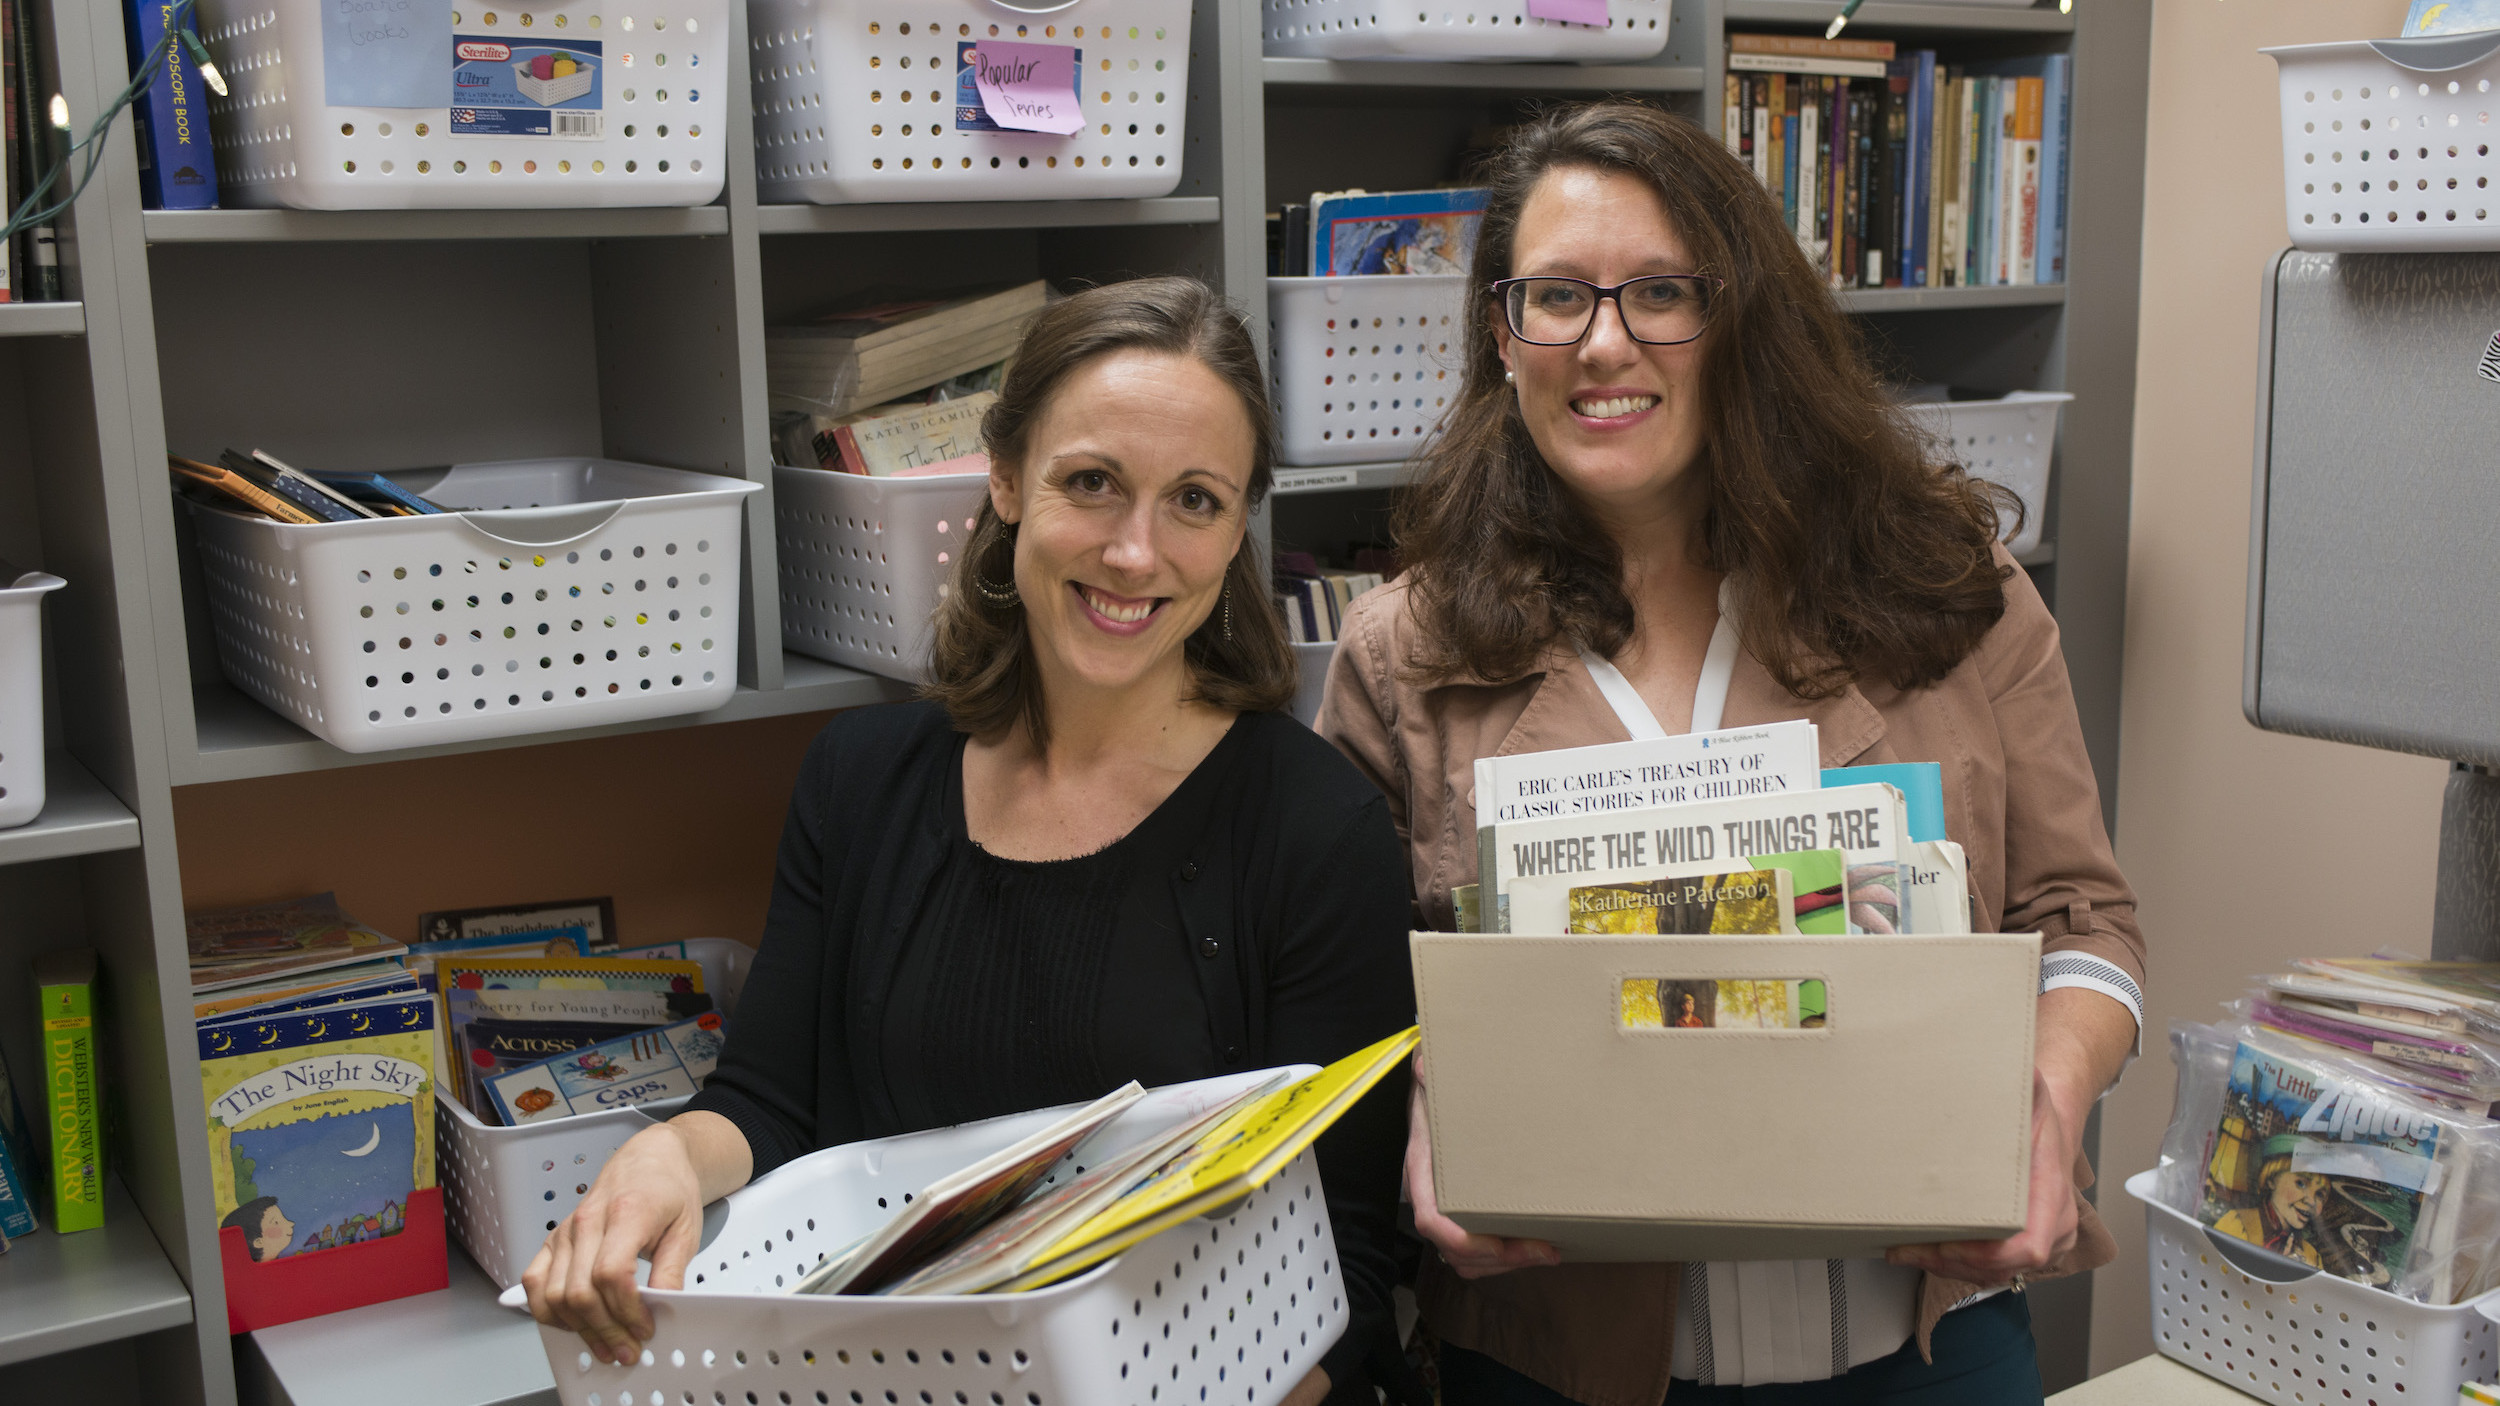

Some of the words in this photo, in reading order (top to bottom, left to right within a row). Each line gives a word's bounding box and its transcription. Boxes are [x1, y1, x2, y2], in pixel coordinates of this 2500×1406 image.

[462, 45, 504, 59] Sterilite
[161, 5, 187, 106] KAIDOSCOPE
[174, 108, 191, 145] BOOK
[456, 71, 491, 85] Ultra
[979, 53, 1041, 93] Popular
[864, 425, 904, 442] KATE
[911, 407, 986, 431] DiCAMILL
[900, 445, 933, 468] The
[276, 503, 305, 524] Farmer
[1518, 776, 1558, 797] ERIC
[1563, 768, 1633, 792] CARLE'S
[1638, 757, 1732, 784] TREASURY
[1740, 753, 1766, 772] OF
[1500, 799, 1567, 821] CLASSIC
[1572, 790, 1644, 813] STORIES
[1651, 784, 1687, 804] FOR
[1694, 774, 1788, 800] CHILDREN
[1513, 836, 1597, 877] WHERE
[1602, 831, 1647, 870] THE
[1656, 824, 1715, 864] WILD
[1723, 814, 1817, 858] THINGS
[1826, 807, 1881, 852] ARE
[1578, 888, 1678, 915] Katherine
[1684, 879, 1773, 906] Paterson
[469, 927, 495, 939] The
[468, 1000, 522, 1015] Poetry
[530, 1000, 555, 1012] for
[560, 1002, 608, 1018] Young
[613, 1001, 667, 1020] People
[490, 1034, 577, 1053] ACROSS
[73, 1037, 92, 1116] WEBSTER'S
[218, 1084, 276, 1116] The
[281, 1059, 364, 1091] Night
[370, 1059, 420, 1092] Sky
[595, 1077, 669, 1106] Caps,
[2263, 1061, 2277, 1075] The
[2276, 1067, 2318, 1103] Little
[53, 1037, 84, 1206] DICTIONARY
[293, 1104, 303, 1112] by
[304, 1102, 322, 1110] June
[323, 1096, 349, 1107] English
[2297, 1075, 2436, 1142] Ziploc
[80, 1119, 94, 1151] NEW
